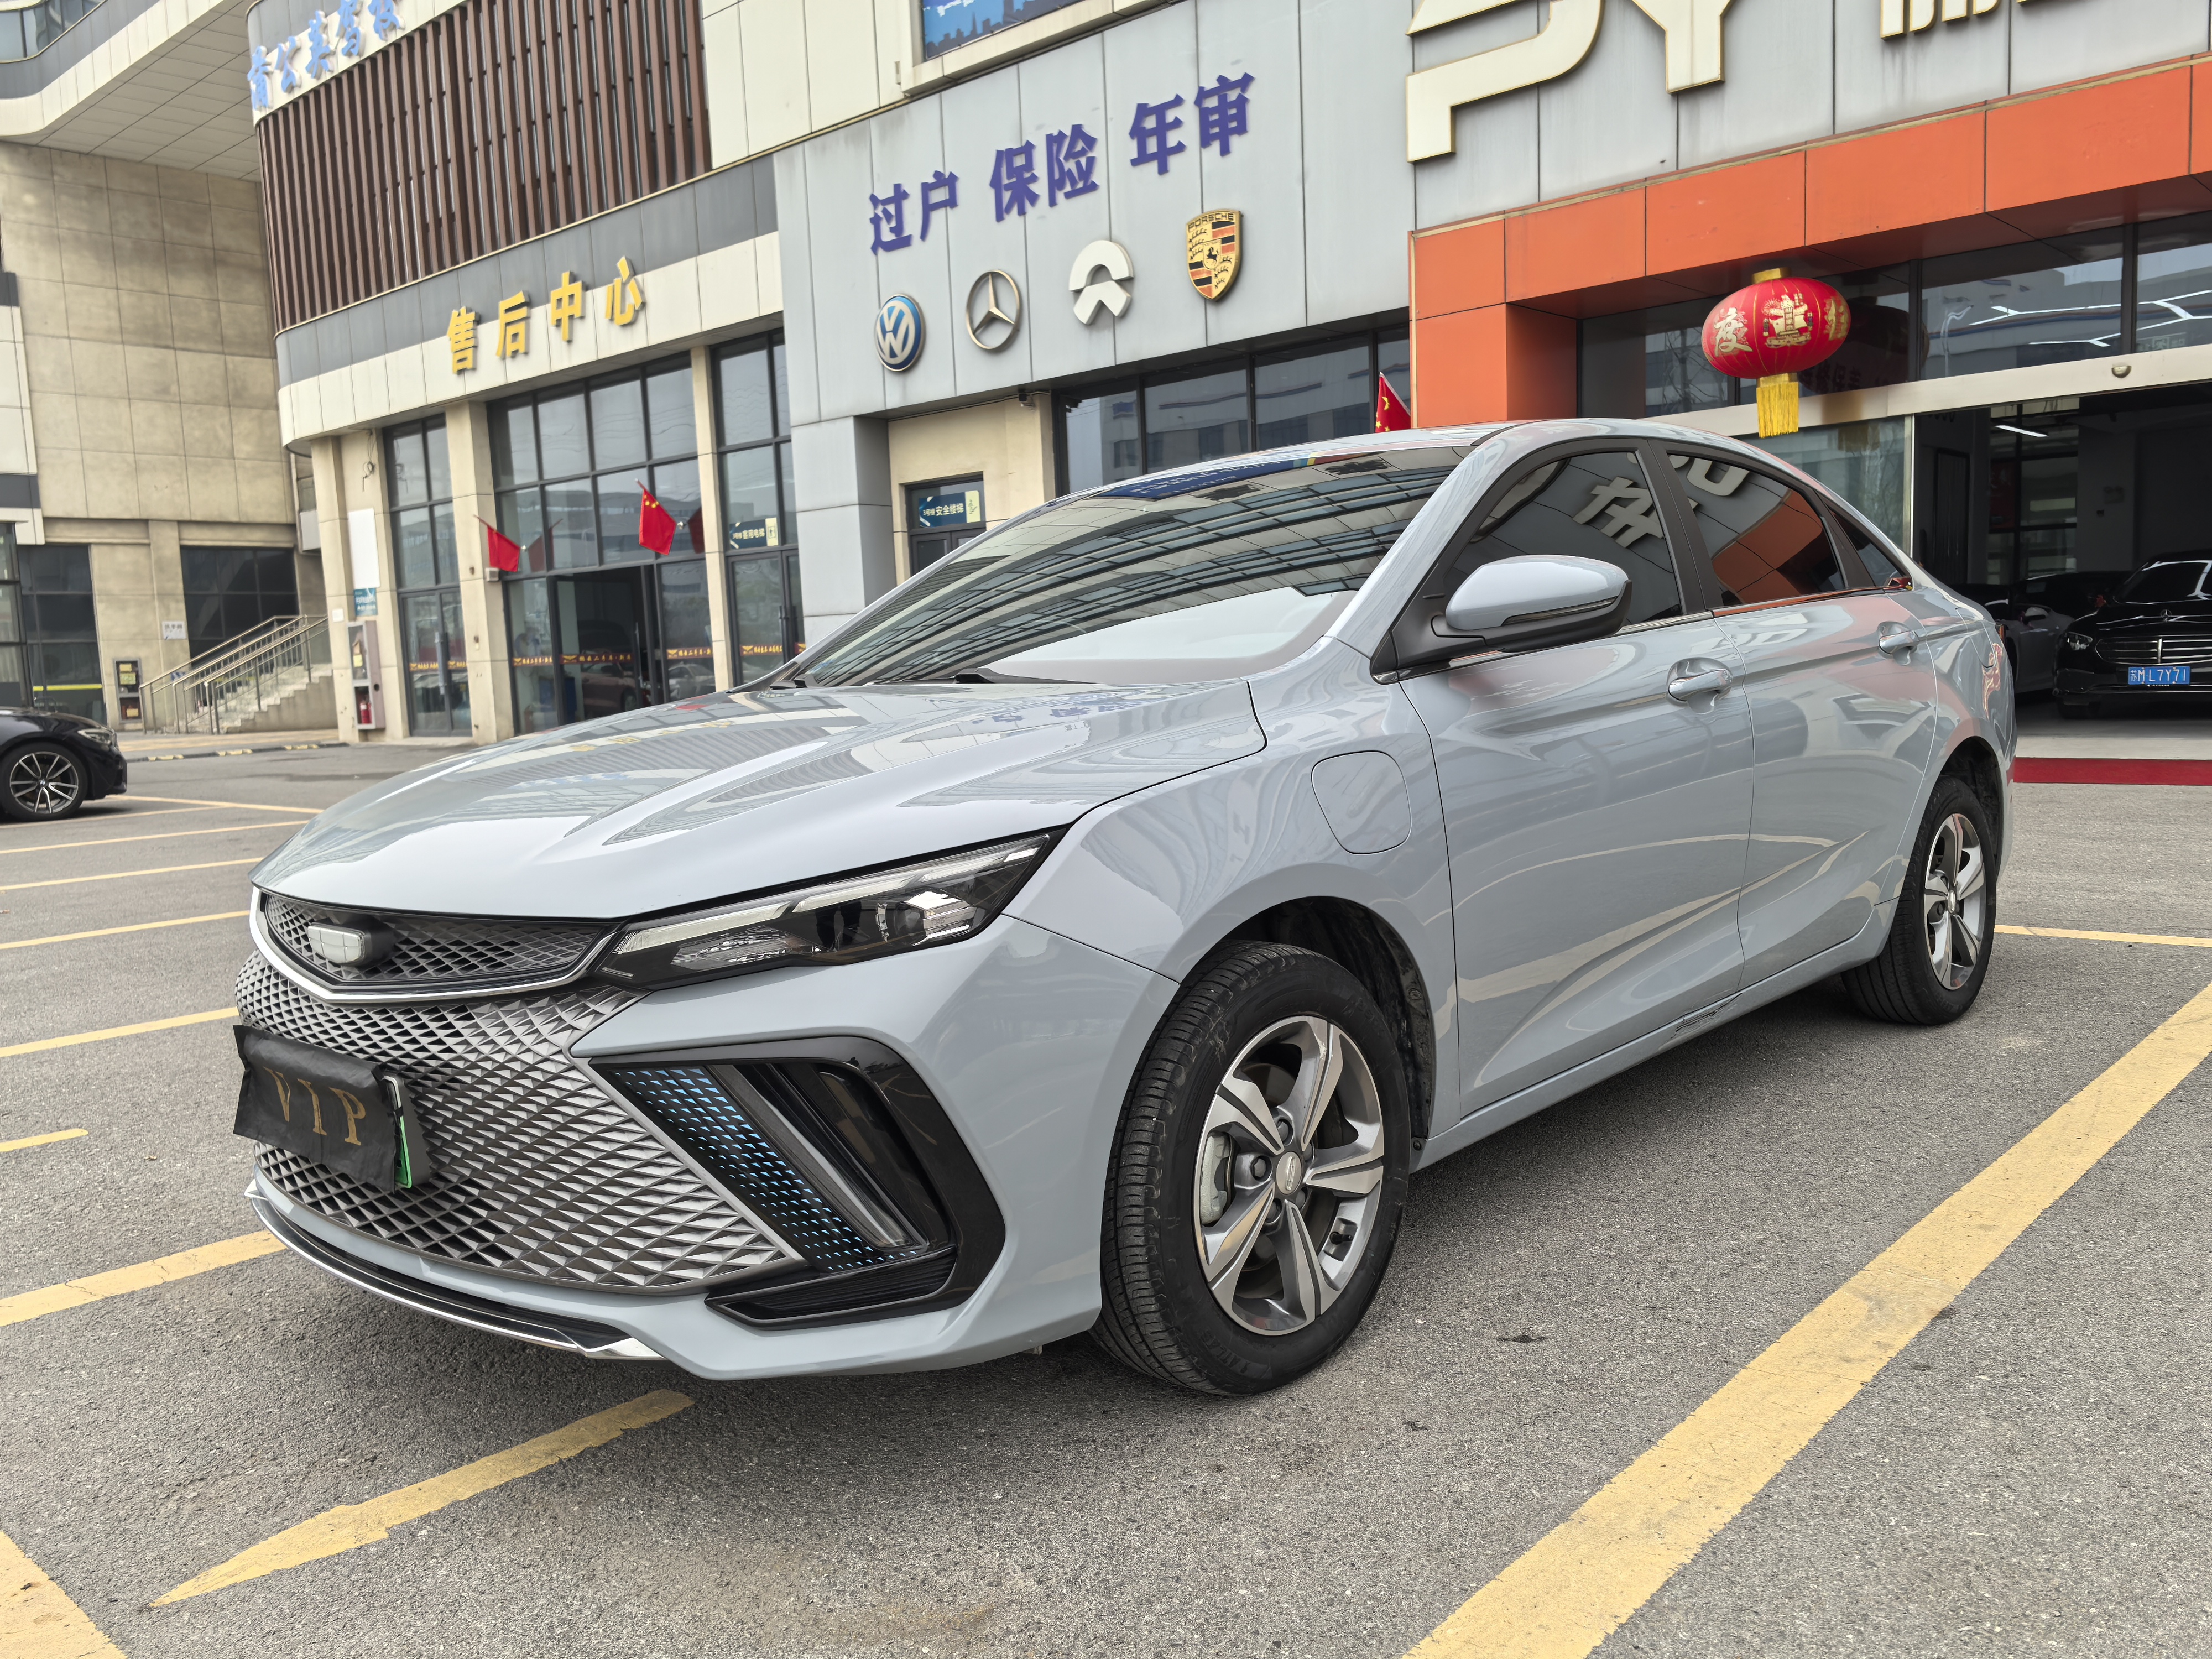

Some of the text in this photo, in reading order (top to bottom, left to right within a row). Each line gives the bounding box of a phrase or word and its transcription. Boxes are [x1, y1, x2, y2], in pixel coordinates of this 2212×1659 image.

[870, 72, 1255, 255] 过户 保险 年审
[1188, 212, 1234, 231] PORSCHE
[447, 256, 645, 374] 售后中心
[263, 1066, 366, 1146] VIP
